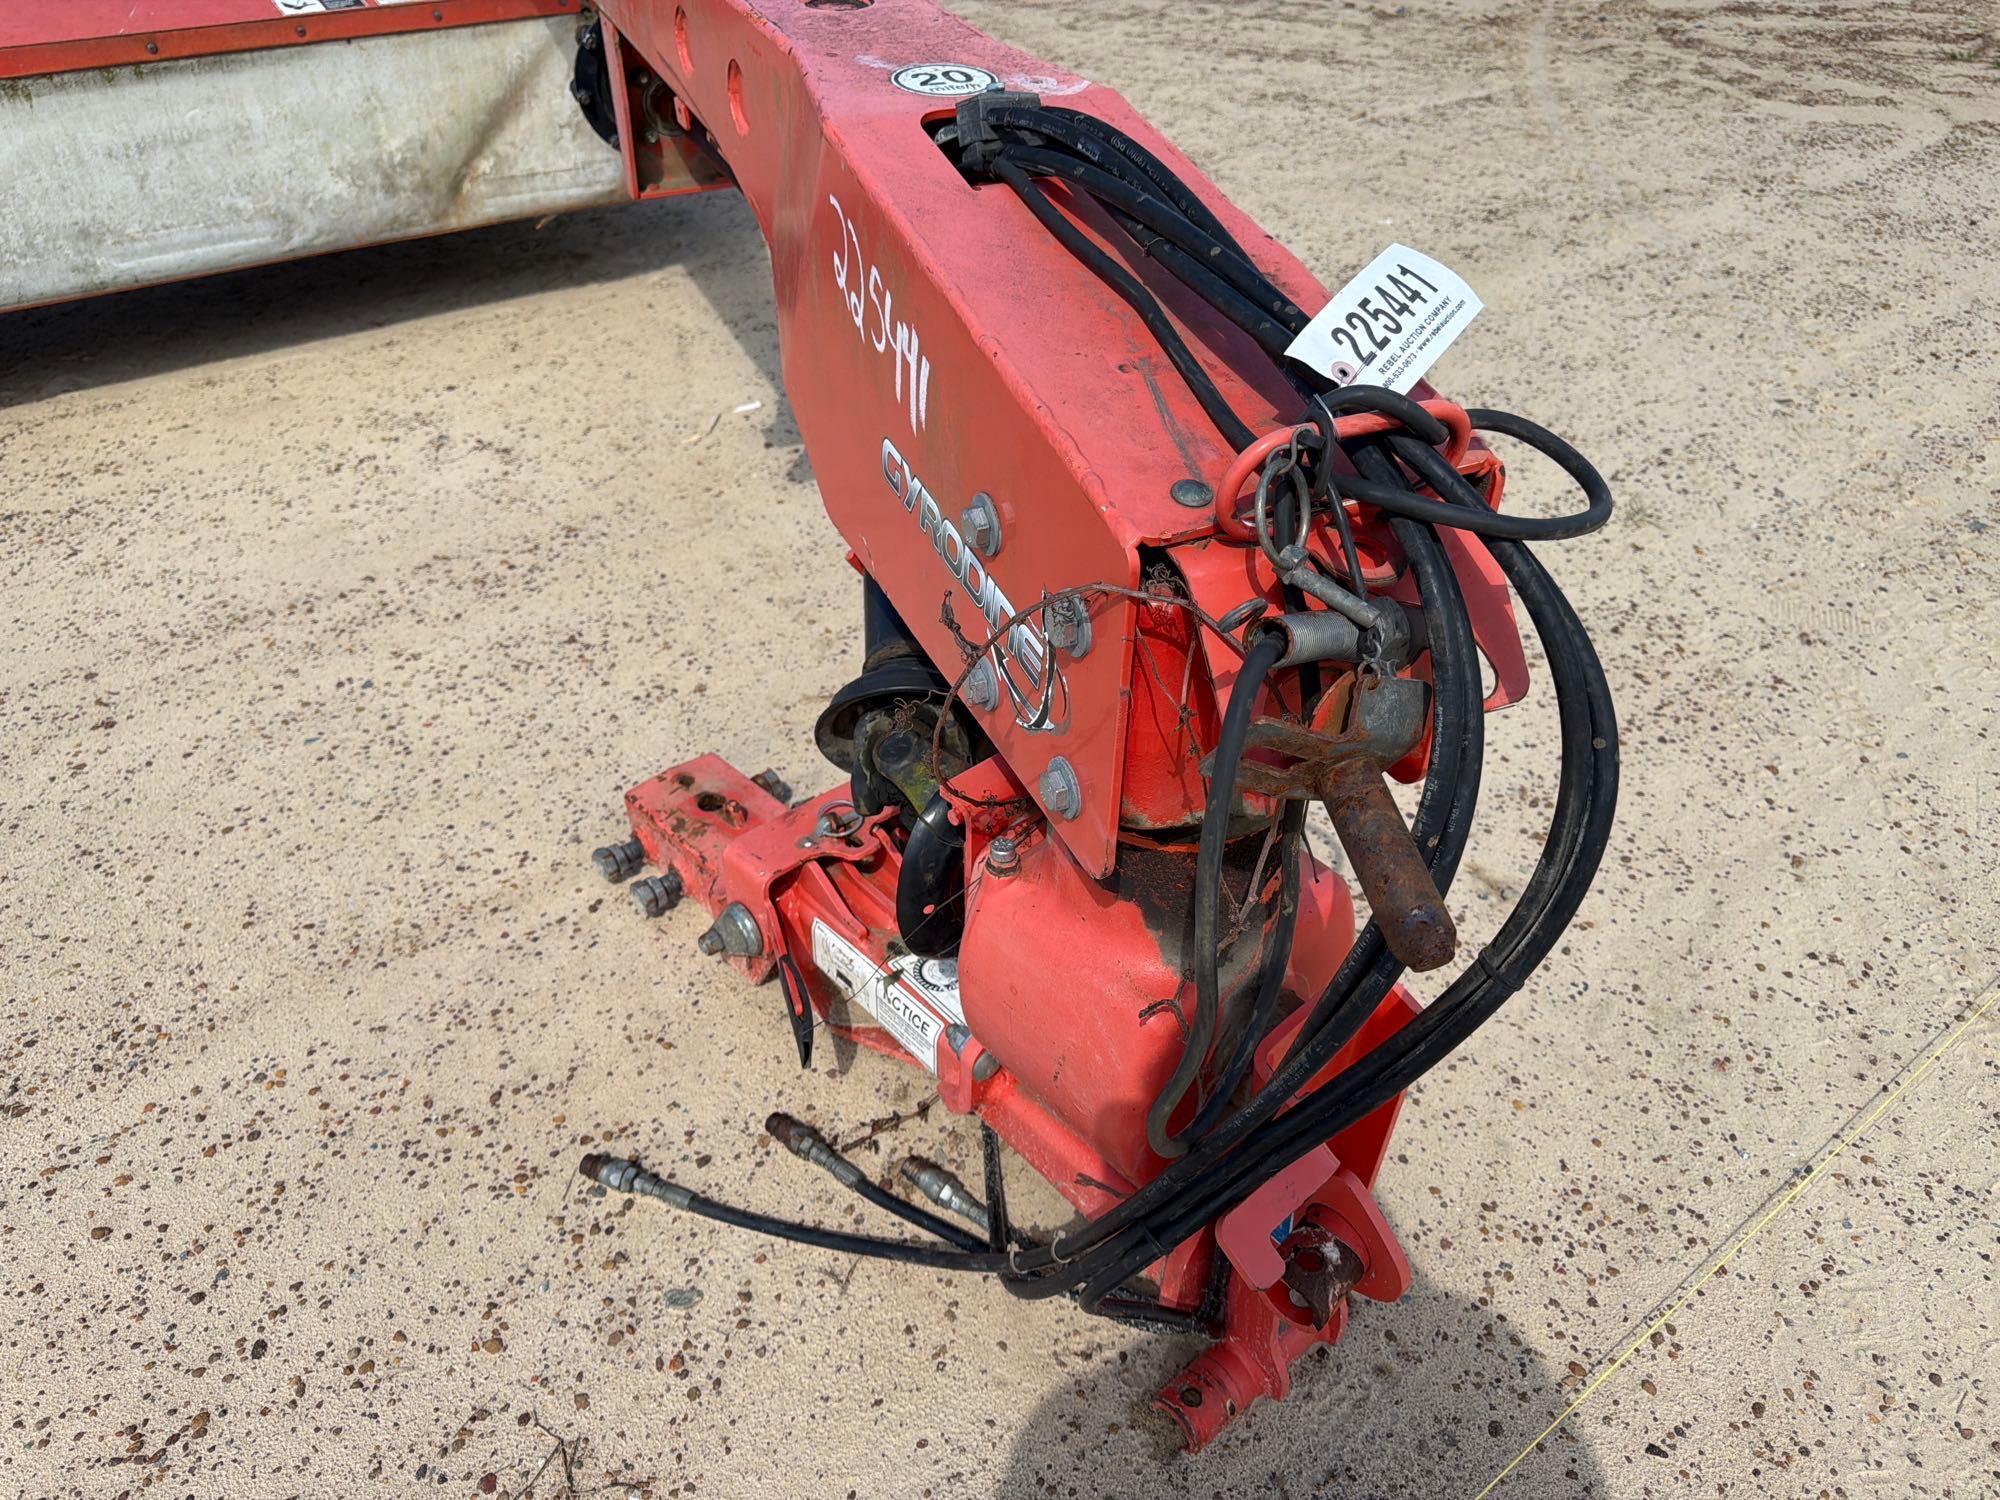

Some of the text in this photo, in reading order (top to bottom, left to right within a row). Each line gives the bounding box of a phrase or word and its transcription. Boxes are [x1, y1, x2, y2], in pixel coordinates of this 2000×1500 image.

[911, 70, 973, 86] 20
[1330, 263, 1438, 367] 225441
[1378, 295, 1452, 375] REBEL AUCTION COMPANY
[881, 436, 1045, 692] GYRODINE
